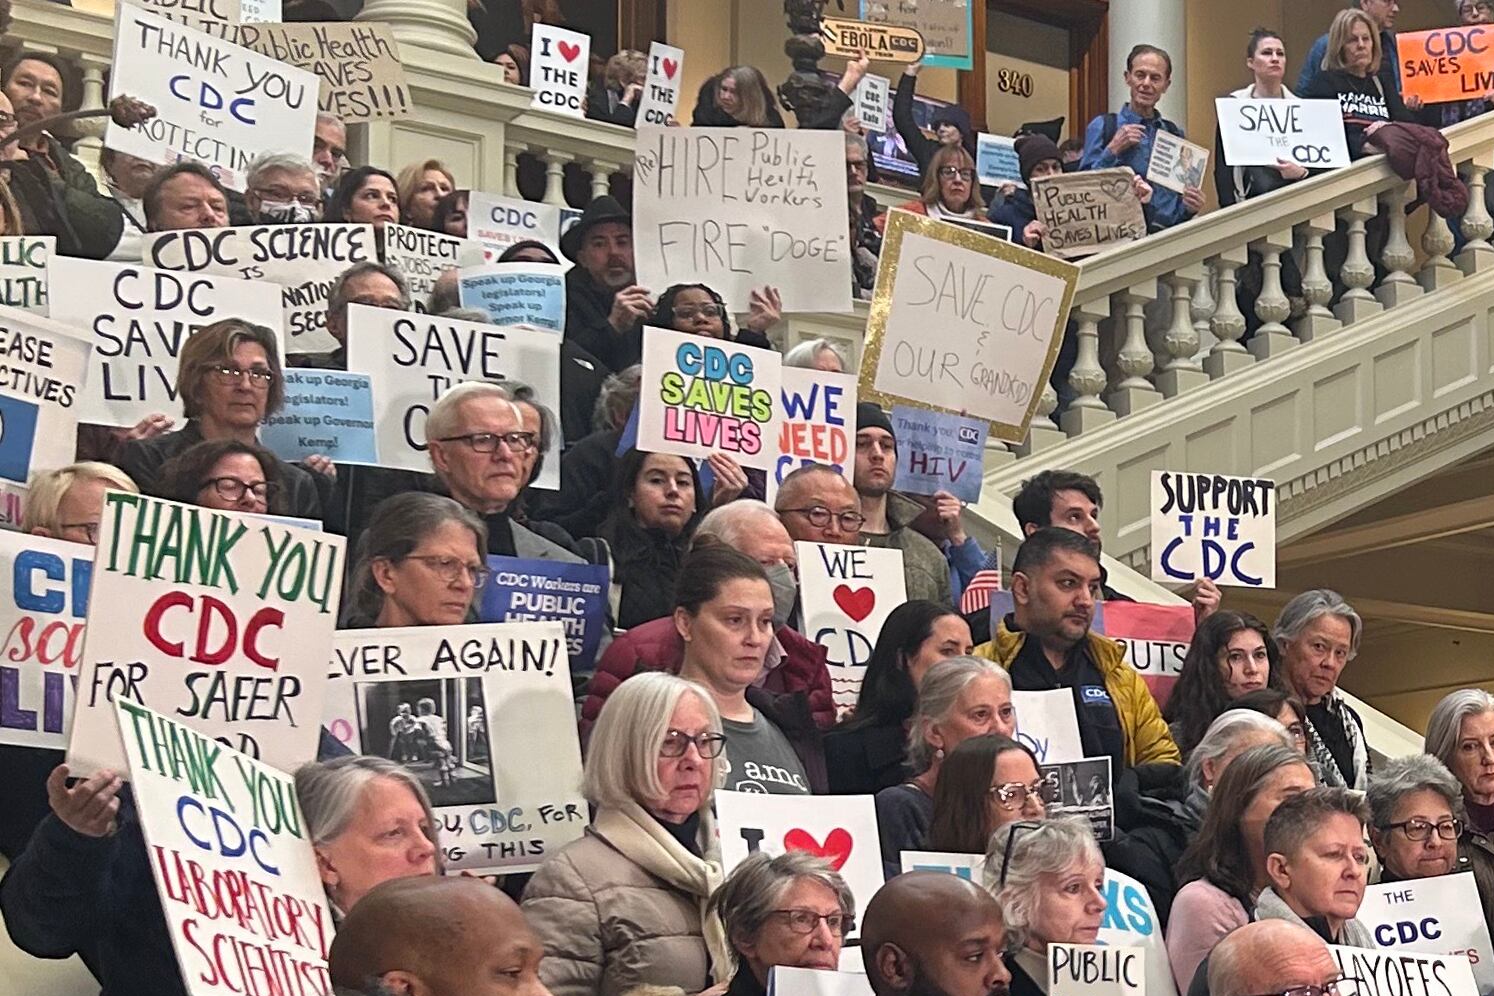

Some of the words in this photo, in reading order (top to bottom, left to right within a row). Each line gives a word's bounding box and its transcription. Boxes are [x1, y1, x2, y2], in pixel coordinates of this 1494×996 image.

[240, 24, 314, 62] Public
[313, 26, 400, 63] Health
[540, 37, 551, 57] I
[841, 30, 888, 51] EBOLA
[891, 37, 916, 48] CDC
[1424, 29, 1490, 58] CDC
[135, 19, 231, 78] THANK
[235, 62, 304, 109] YOU
[294, 61, 373, 88] AVES
[541, 66, 578, 88] THE
[652, 55, 660, 76] I
[1404, 57, 1462, 79] SAVES
[650, 84, 674, 105] THE
[997, 69, 1033, 99] 340
[169, 75, 256, 125] CDC
[318, 85, 407, 121] VES!!!
[539, 90, 580, 110] CDC
[200, 111, 223, 128] for
[645, 108, 673, 126] CDC
[1238, 105, 1303, 134] SAVE
[137, 117, 254, 172] ROTECTIN
[1267, 136, 1291, 148] THE
[1292, 145, 1331, 163] CDC
[658, 134, 739, 203] HIRE
[752, 131, 816, 167] Public
[747, 167, 818, 191] Health
[1044, 186, 1095, 208] PUBLIC
[491, 206, 537, 229] CDC
[1044, 204, 1107, 228] HEALTH
[2, 238, 47, 268] LIC
[152, 230, 239, 271] CDC
[250, 226, 367, 262] SCIENCE
[387, 226, 460, 260] PROTECT
[658, 219, 753, 275] FIRE
[762, 225, 844, 263] "DOGE"
[1050, 228, 1092, 249] SAVES
[239, 265, 264, 280] IS
[500, 277, 516, 285] up
[0, 276, 49, 307] LTH
[113, 269, 215, 316] CDC
[906, 255, 994, 325] SAVE
[1000, 284, 1054, 343] CDC
[527, 303, 542, 311] up
[393, 318, 506, 380] SAVE
[676, 342, 754, 385] CDC
[893, 341, 963, 389] OUR
[306, 376, 322, 386] up
[324, 375, 369, 390] Georgia
[660, 371, 773, 423] SAVES
[284, 394, 349, 406] egislators!
[781, 382, 845, 426] WE
[304, 417, 321, 426] up
[664, 406, 762, 455] LIVES
[898, 418, 930, 433] Thank
[298, 436, 338, 450] Kemp!
[910, 451, 966, 483] HIV
[1160, 472, 1274, 517] SUPPORT
[1178, 515, 1240, 540] THE
[105, 493, 248, 595] THANK
[256, 525, 338, 613] YOU
[817, 545, 873, 579] WE
[1160, 537, 1263, 585] CDC
[496, 572, 529, 587] CDC
[531, 575, 581, 592] Workers
[582, 583, 601, 594] are
[510, 591, 586, 615] PUBLIC
[143, 591, 286, 672] CDC
[327, 644, 408, 679] VER
[431, 638, 561, 677] AGAIN!
[815, 627, 873, 668] CD
[89, 661, 149, 707] FOR
[176, 671, 301, 728] SAFER
[119, 700, 236, 813] THANK
[233, 755, 304, 839] YOU
[469, 807, 533, 835] CDC,
[176, 795, 280, 877] CDC
[481, 840, 545, 859] THIS
[740, 827, 764, 856] I
[152, 845, 331, 962] LABORATORY
[1384, 890, 1414, 904] THE
[1375, 918, 1442, 946] CDC
[1053, 947, 1138, 988] PUBLIC
